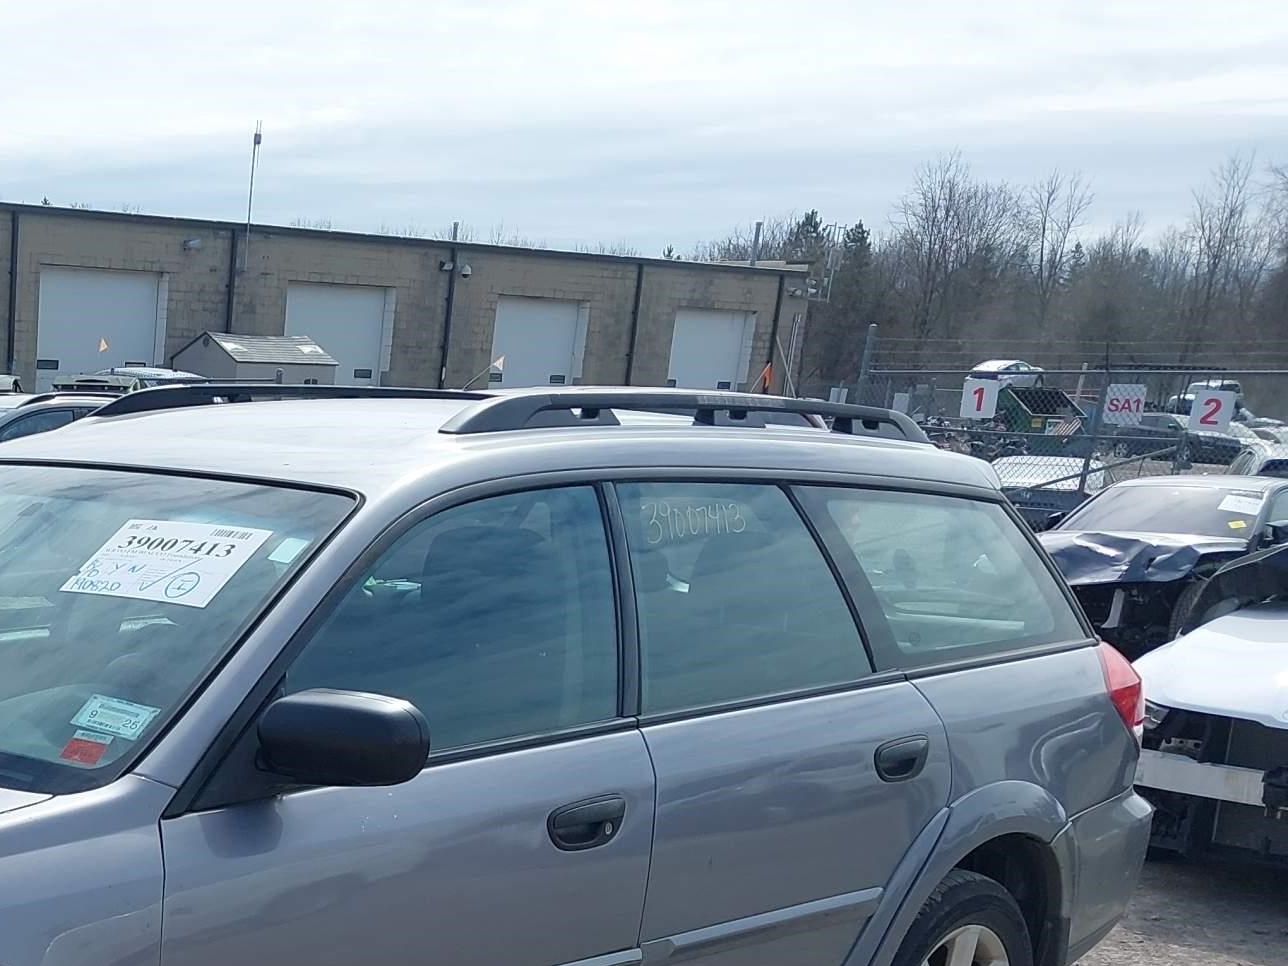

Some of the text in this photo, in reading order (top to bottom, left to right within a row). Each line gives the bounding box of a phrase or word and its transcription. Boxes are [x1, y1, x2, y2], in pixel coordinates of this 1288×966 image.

[973, 386, 985, 412] 1
[1107, 398, 1143, 413] SA1
[1199, 398, 1223, 426] 2
[641, 502, 747, 544] 39007413
[117, 535, 238, 558] 39007413
